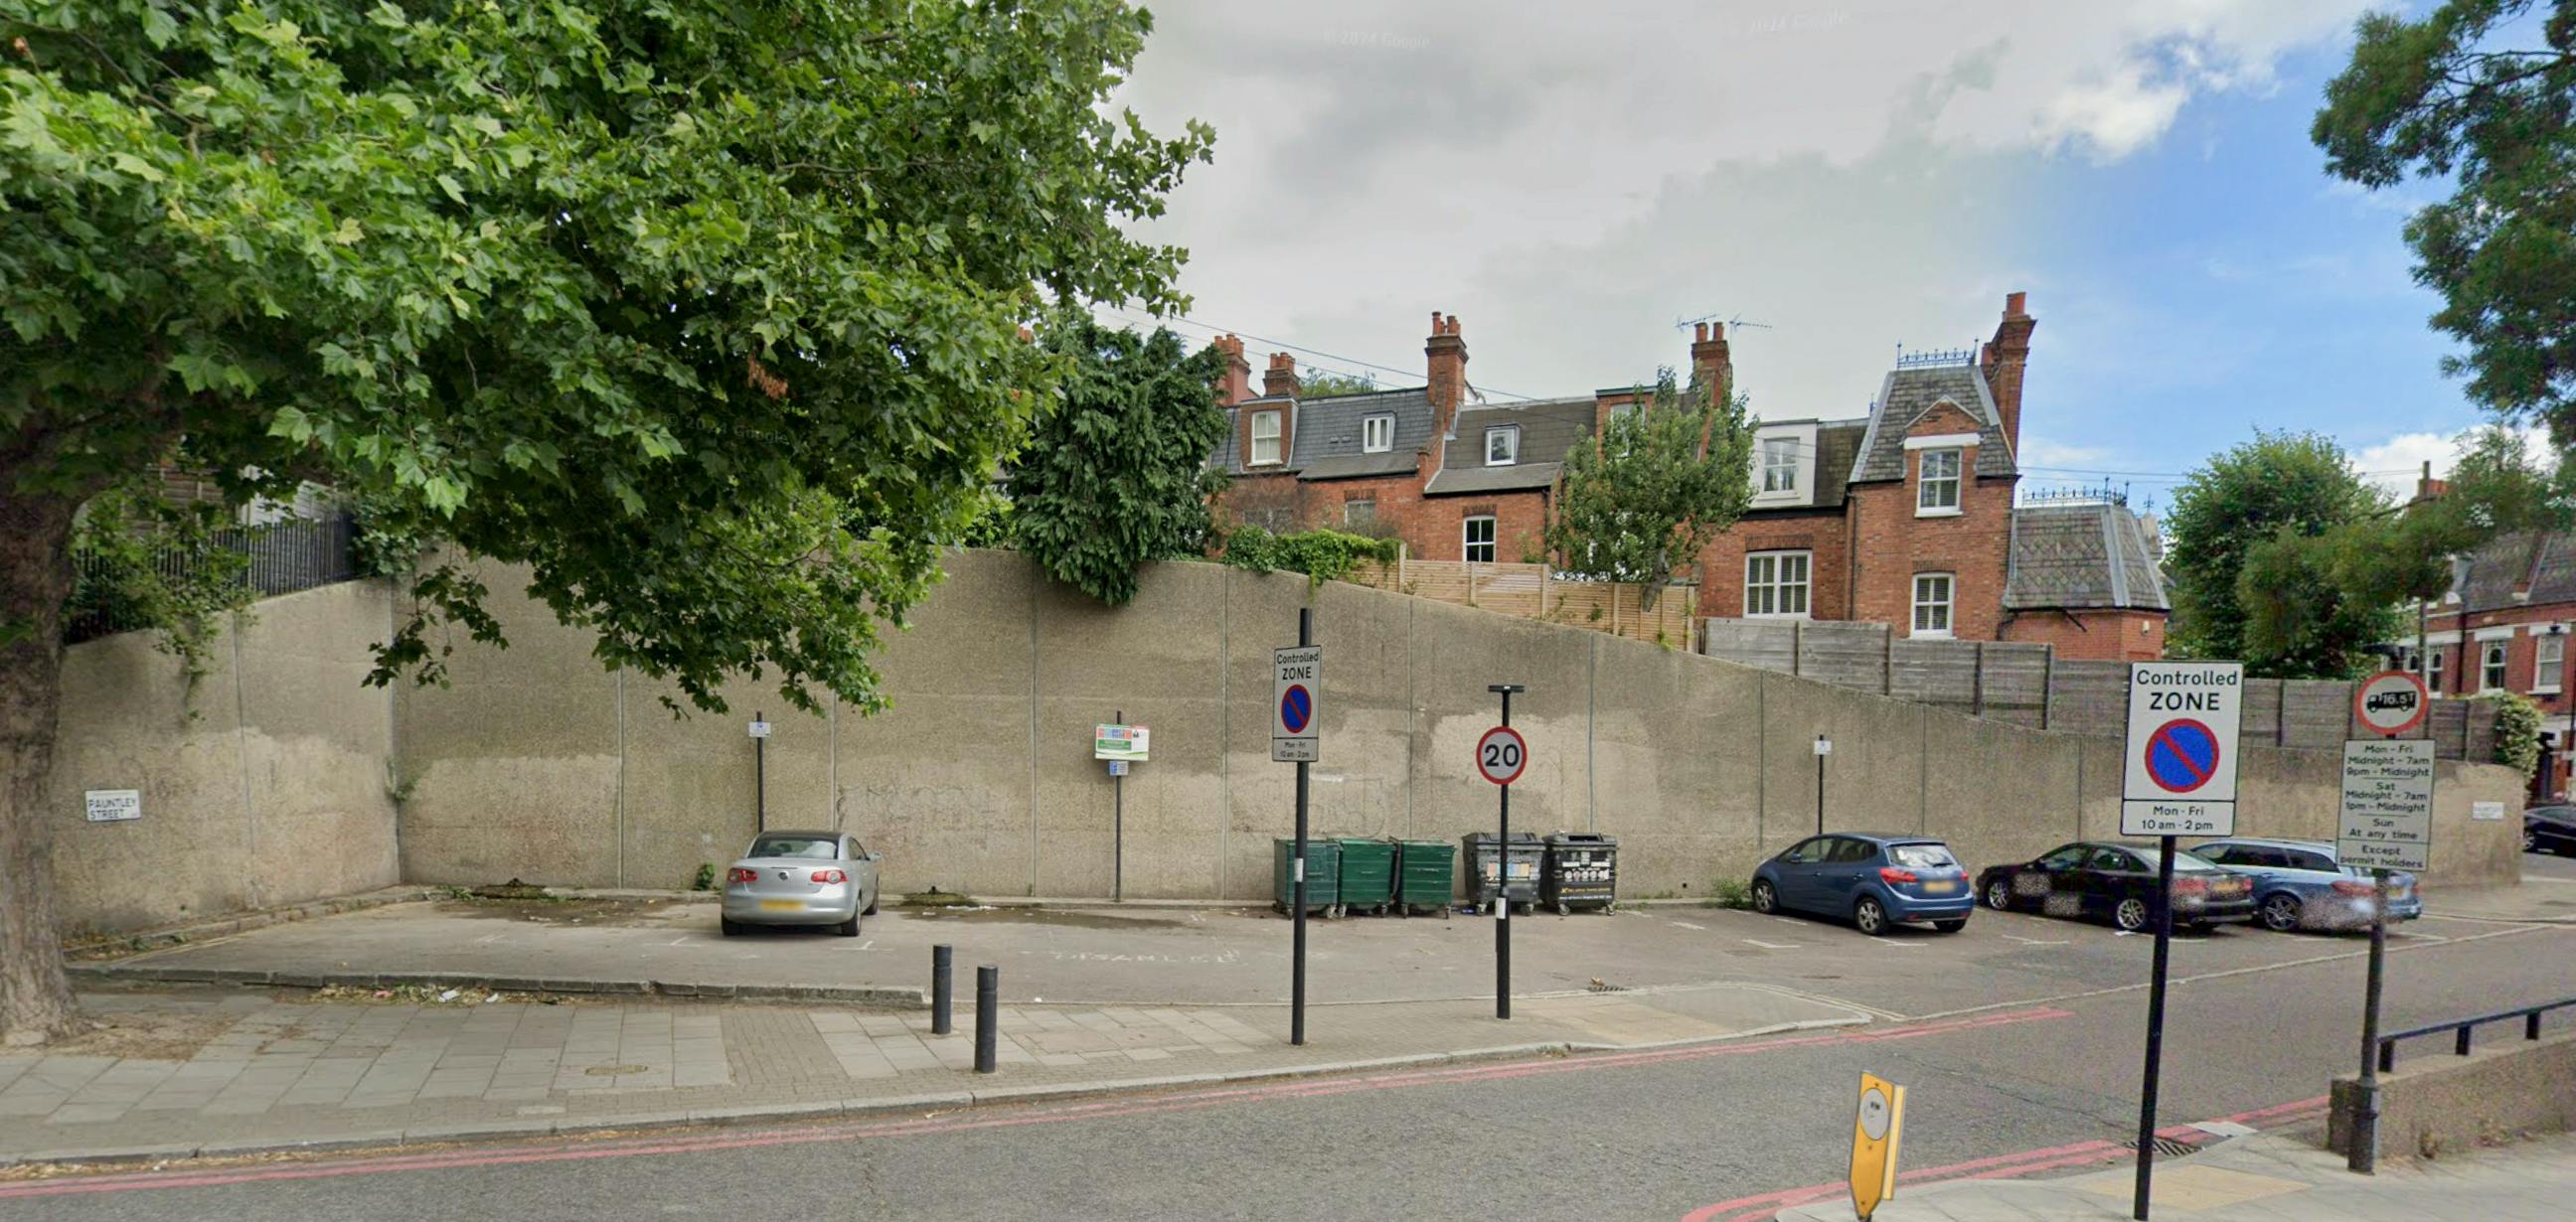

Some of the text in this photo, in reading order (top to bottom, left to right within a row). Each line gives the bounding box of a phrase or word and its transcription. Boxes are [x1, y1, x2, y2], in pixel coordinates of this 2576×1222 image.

[1277, 651, 1319, 665] Controlled
[1282, 667, 1312, 681] ZONE
[2137, 670, 2237, 686] Controlled
[2150, 691, 2220, 711] ZONE
[1485, 743, 1521, 768] 20
[2347, 756, 2394, 766] Midnight
[2380, 768, 2429, 777] Midnight
[2376, 782, 2395, 791] Sat
[2345, 791, 2391, 801] Midnight
[2404, 792, 2428, 801] 7am
[2153, 806, 2178, 816] Mon
[2188, 806, 2204, 816] Fri
[2376, 803, 2425, 813] Midnight
[90, 809, 124, 820] STREET
[2142, 820, 2156, 830] 10
[2158, 822, 2175, 831] am
[2185, 820, 2193, 831] 2
[2194, 822, 2213, 832] pm
[2367, 831, 2386, 840] any
[2362, 844, 2400, 855] Except
[2339, 856, 2423, 868] permit holders
